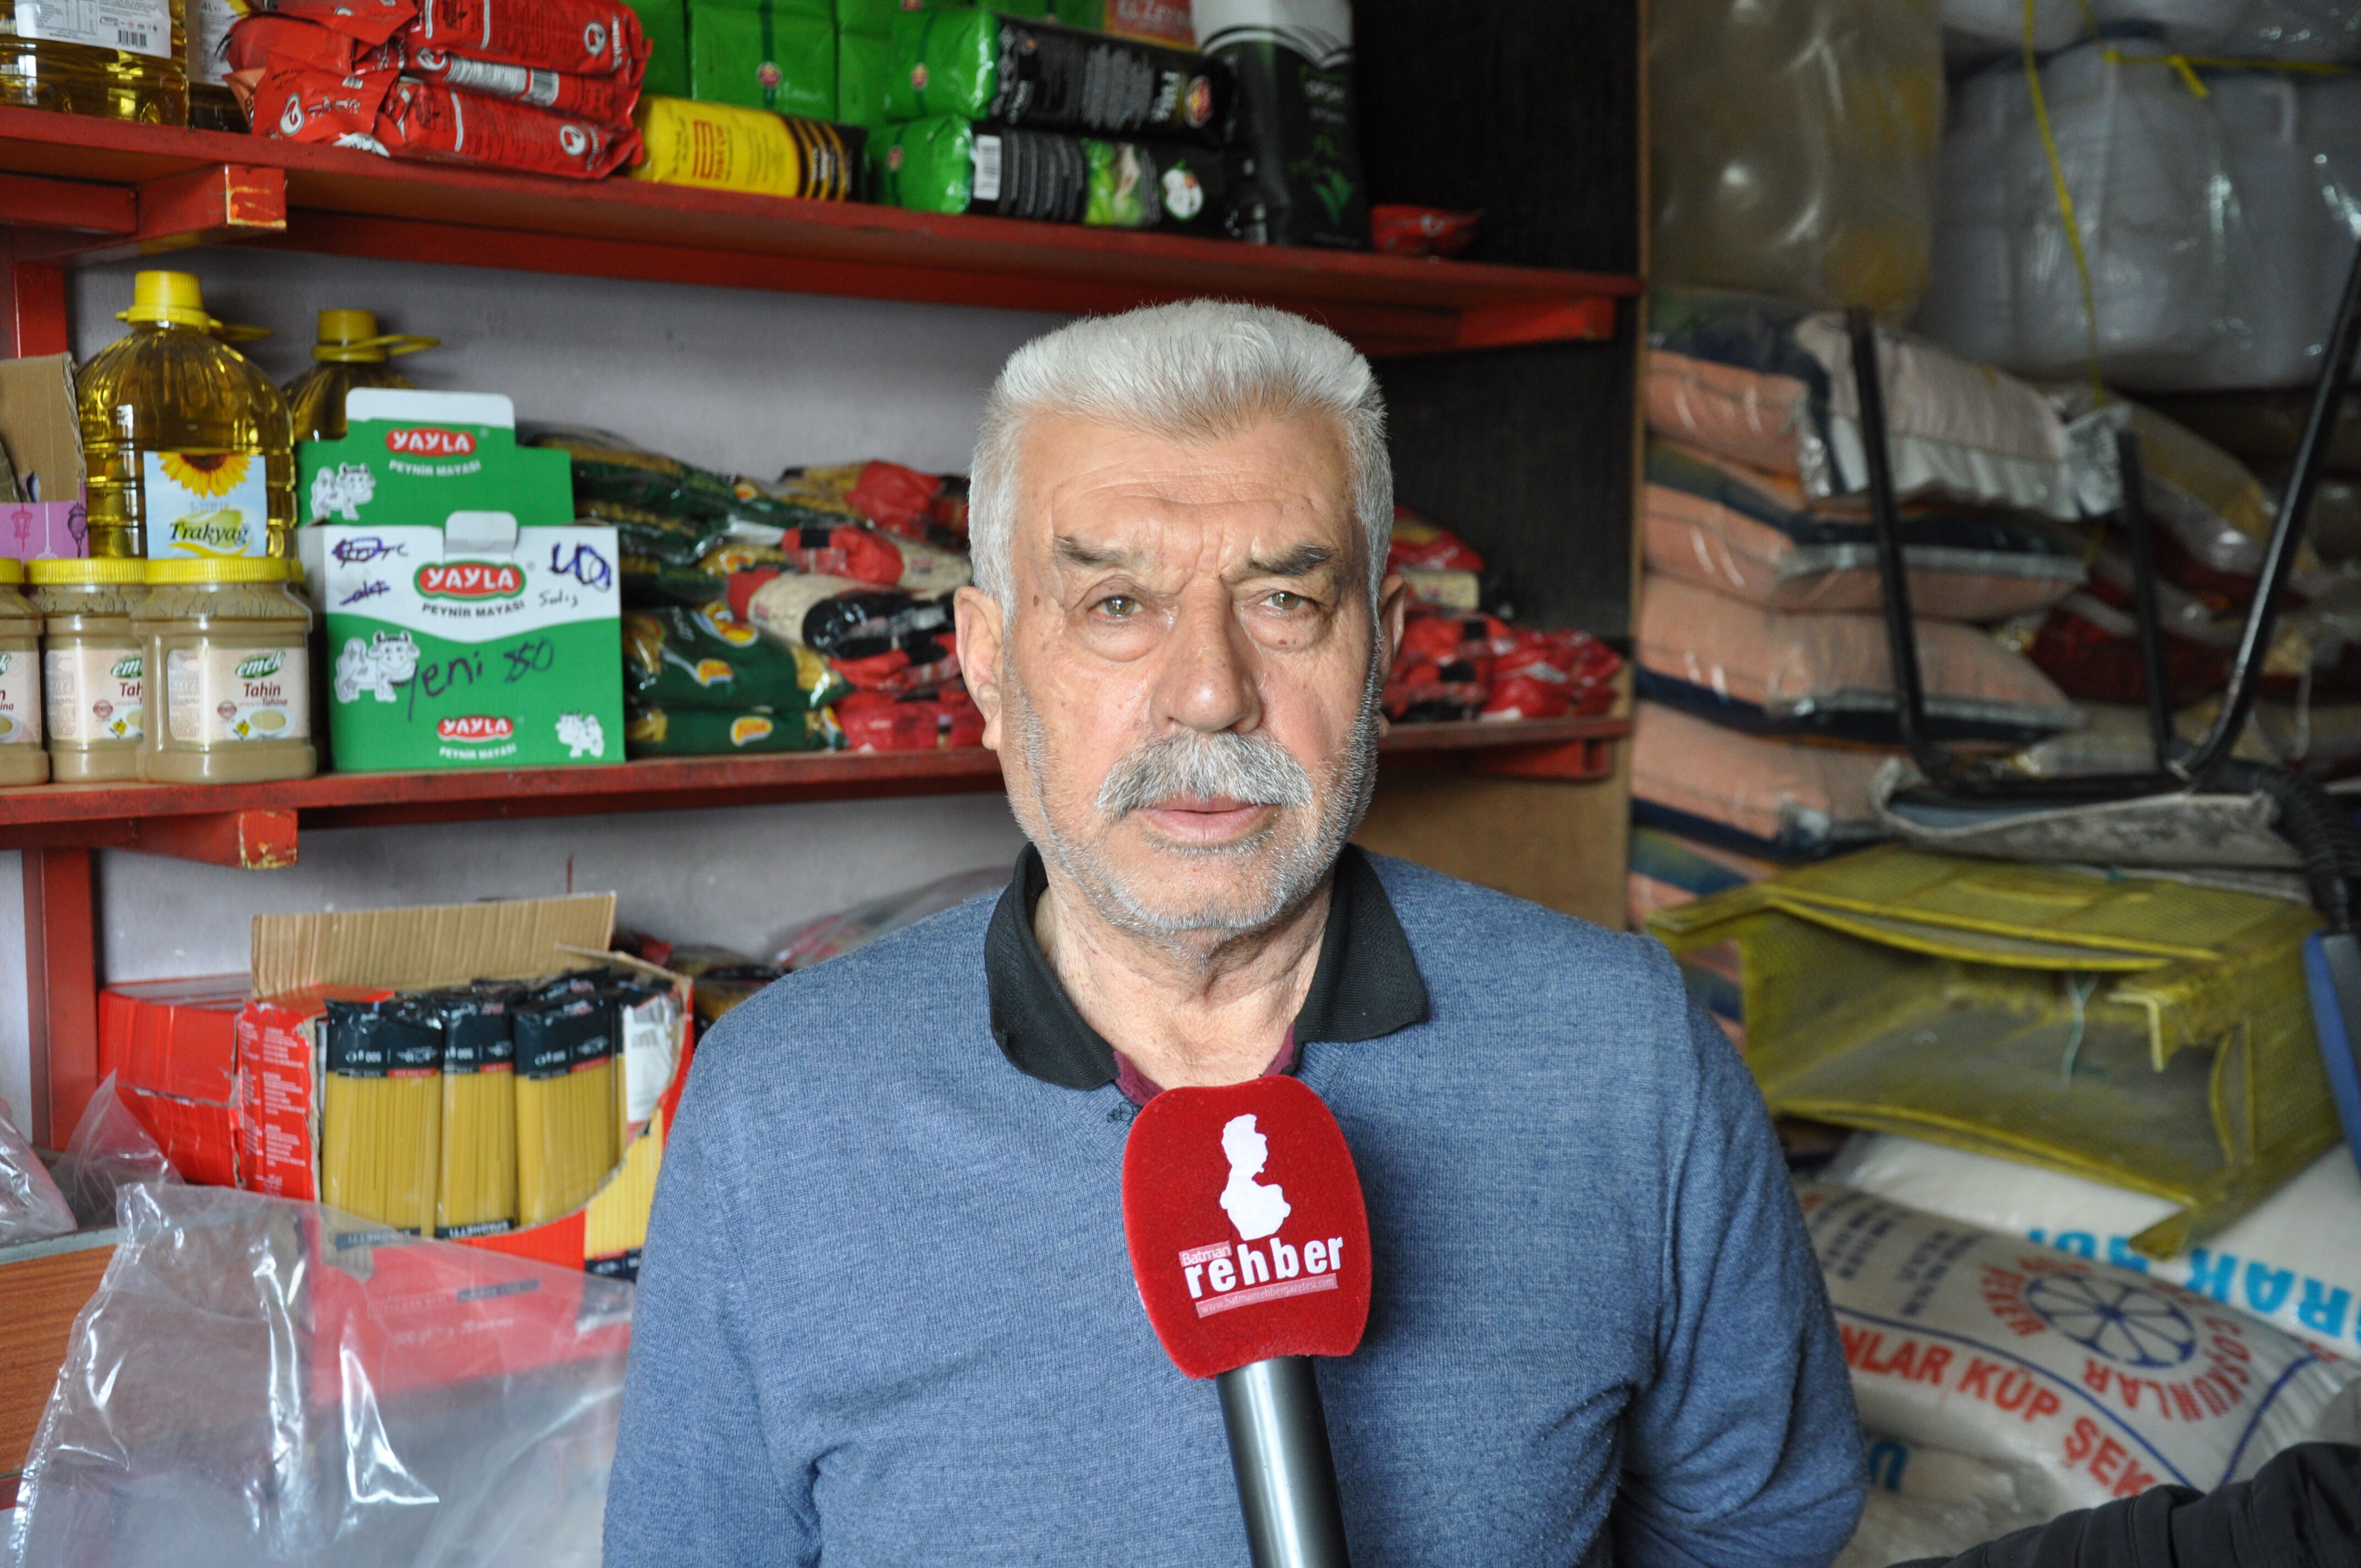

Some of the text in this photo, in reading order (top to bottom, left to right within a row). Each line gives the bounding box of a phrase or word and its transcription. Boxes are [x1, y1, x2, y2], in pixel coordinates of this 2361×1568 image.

[393, 431, 471, 453] YAYLA
[389, 459, 481, 477] PEYNİR MAYASI
[427, 568, 514, 589] YAYLA
[422, 600, 525, 617] PEYNİR MAYASI
[244, 681, 281, 698] Tahin
[443, 717, 508, 734] YAYLA
[1182, 1245, 1232, 1266] Batman
[1184, 1237, 1343, 1299] rehber
[1199, 1278, 1334, 1314] www.batmanrehbergazetesi.com
